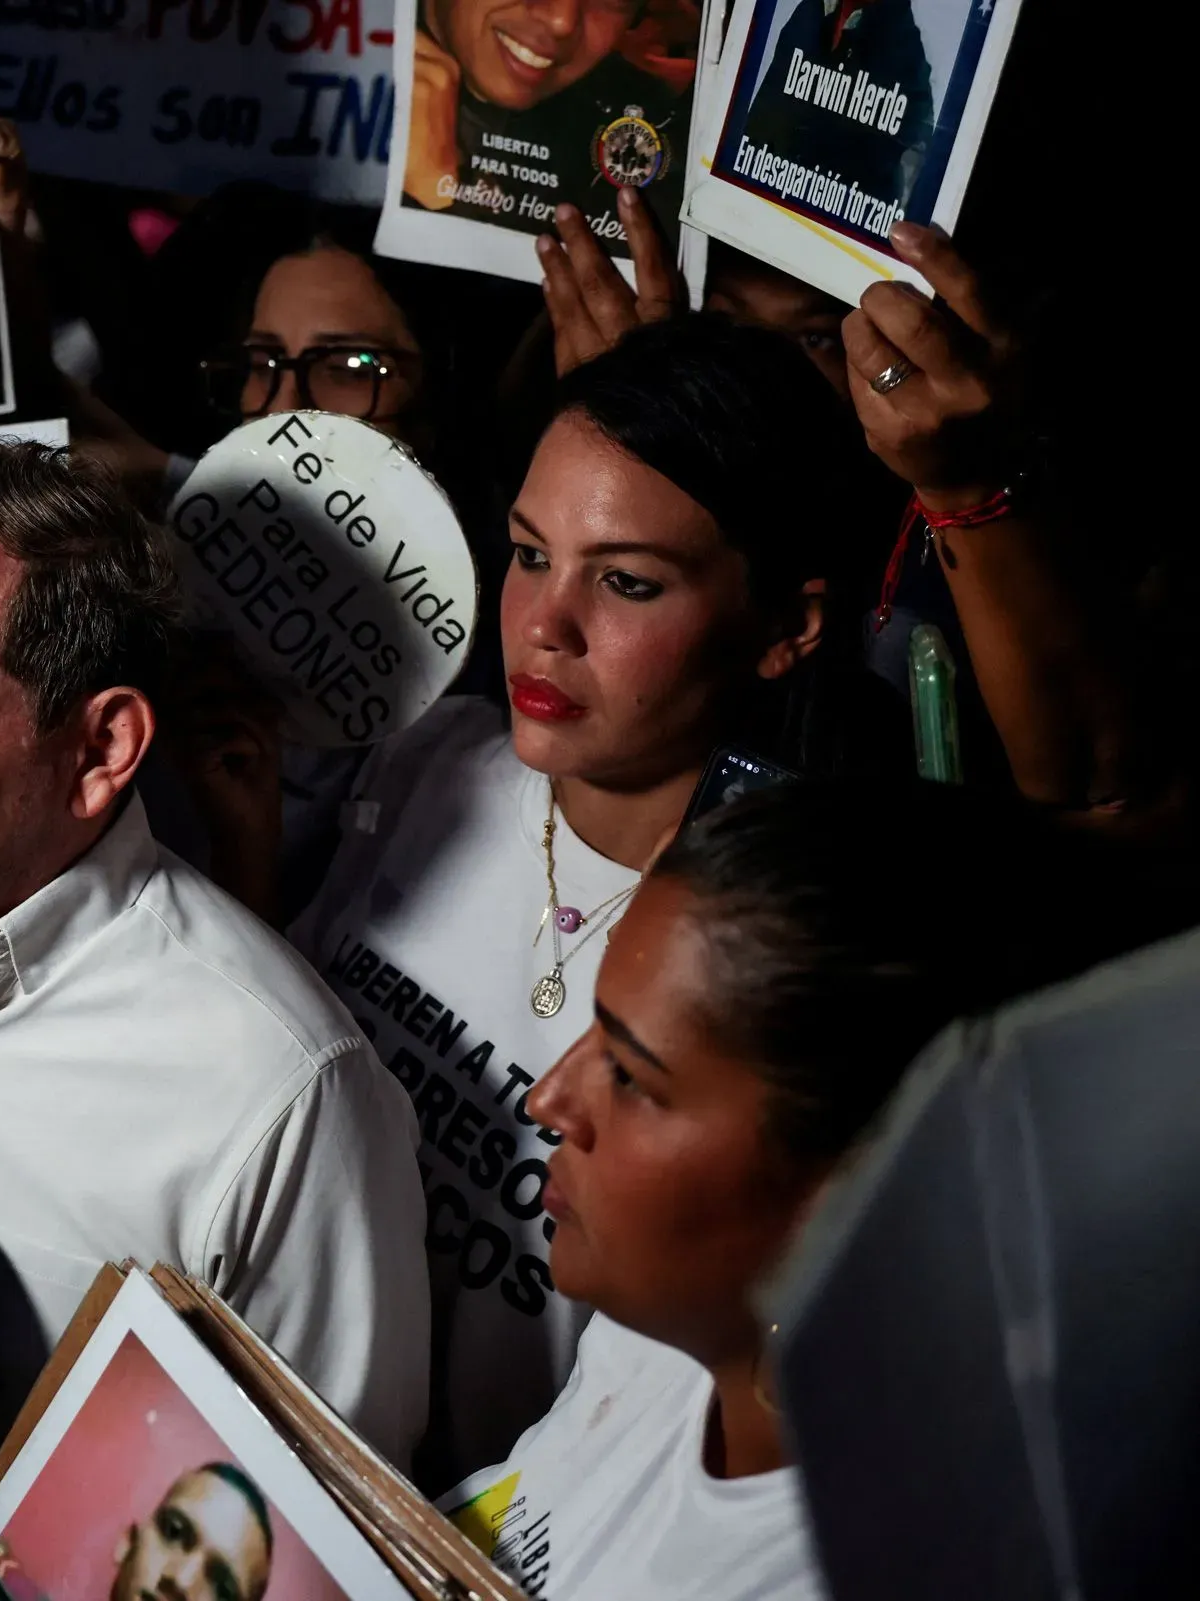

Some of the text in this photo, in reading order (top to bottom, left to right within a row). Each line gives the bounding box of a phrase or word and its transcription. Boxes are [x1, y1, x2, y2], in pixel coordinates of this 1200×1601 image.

[783, 47, 908, 135] Darwin Herde
[471, 155, 560, 189] PARA TODOS
[483, 132, 550, 161] LIBERTAD
[733, 134, 757, 176] En
[751, 143, 847, 217] desaparición
[437, 174, 515, 215] Gustavo
[324, 490, 377, 548] de
[174, 491, 390, 743] GEDEONES
[237, 478, 401, 677] Para Los
[328, 933, 468, 1058] LIBEREN
[456, 1040, 496, 1085] A
[386, 1046, 557, 1244] PRESO
